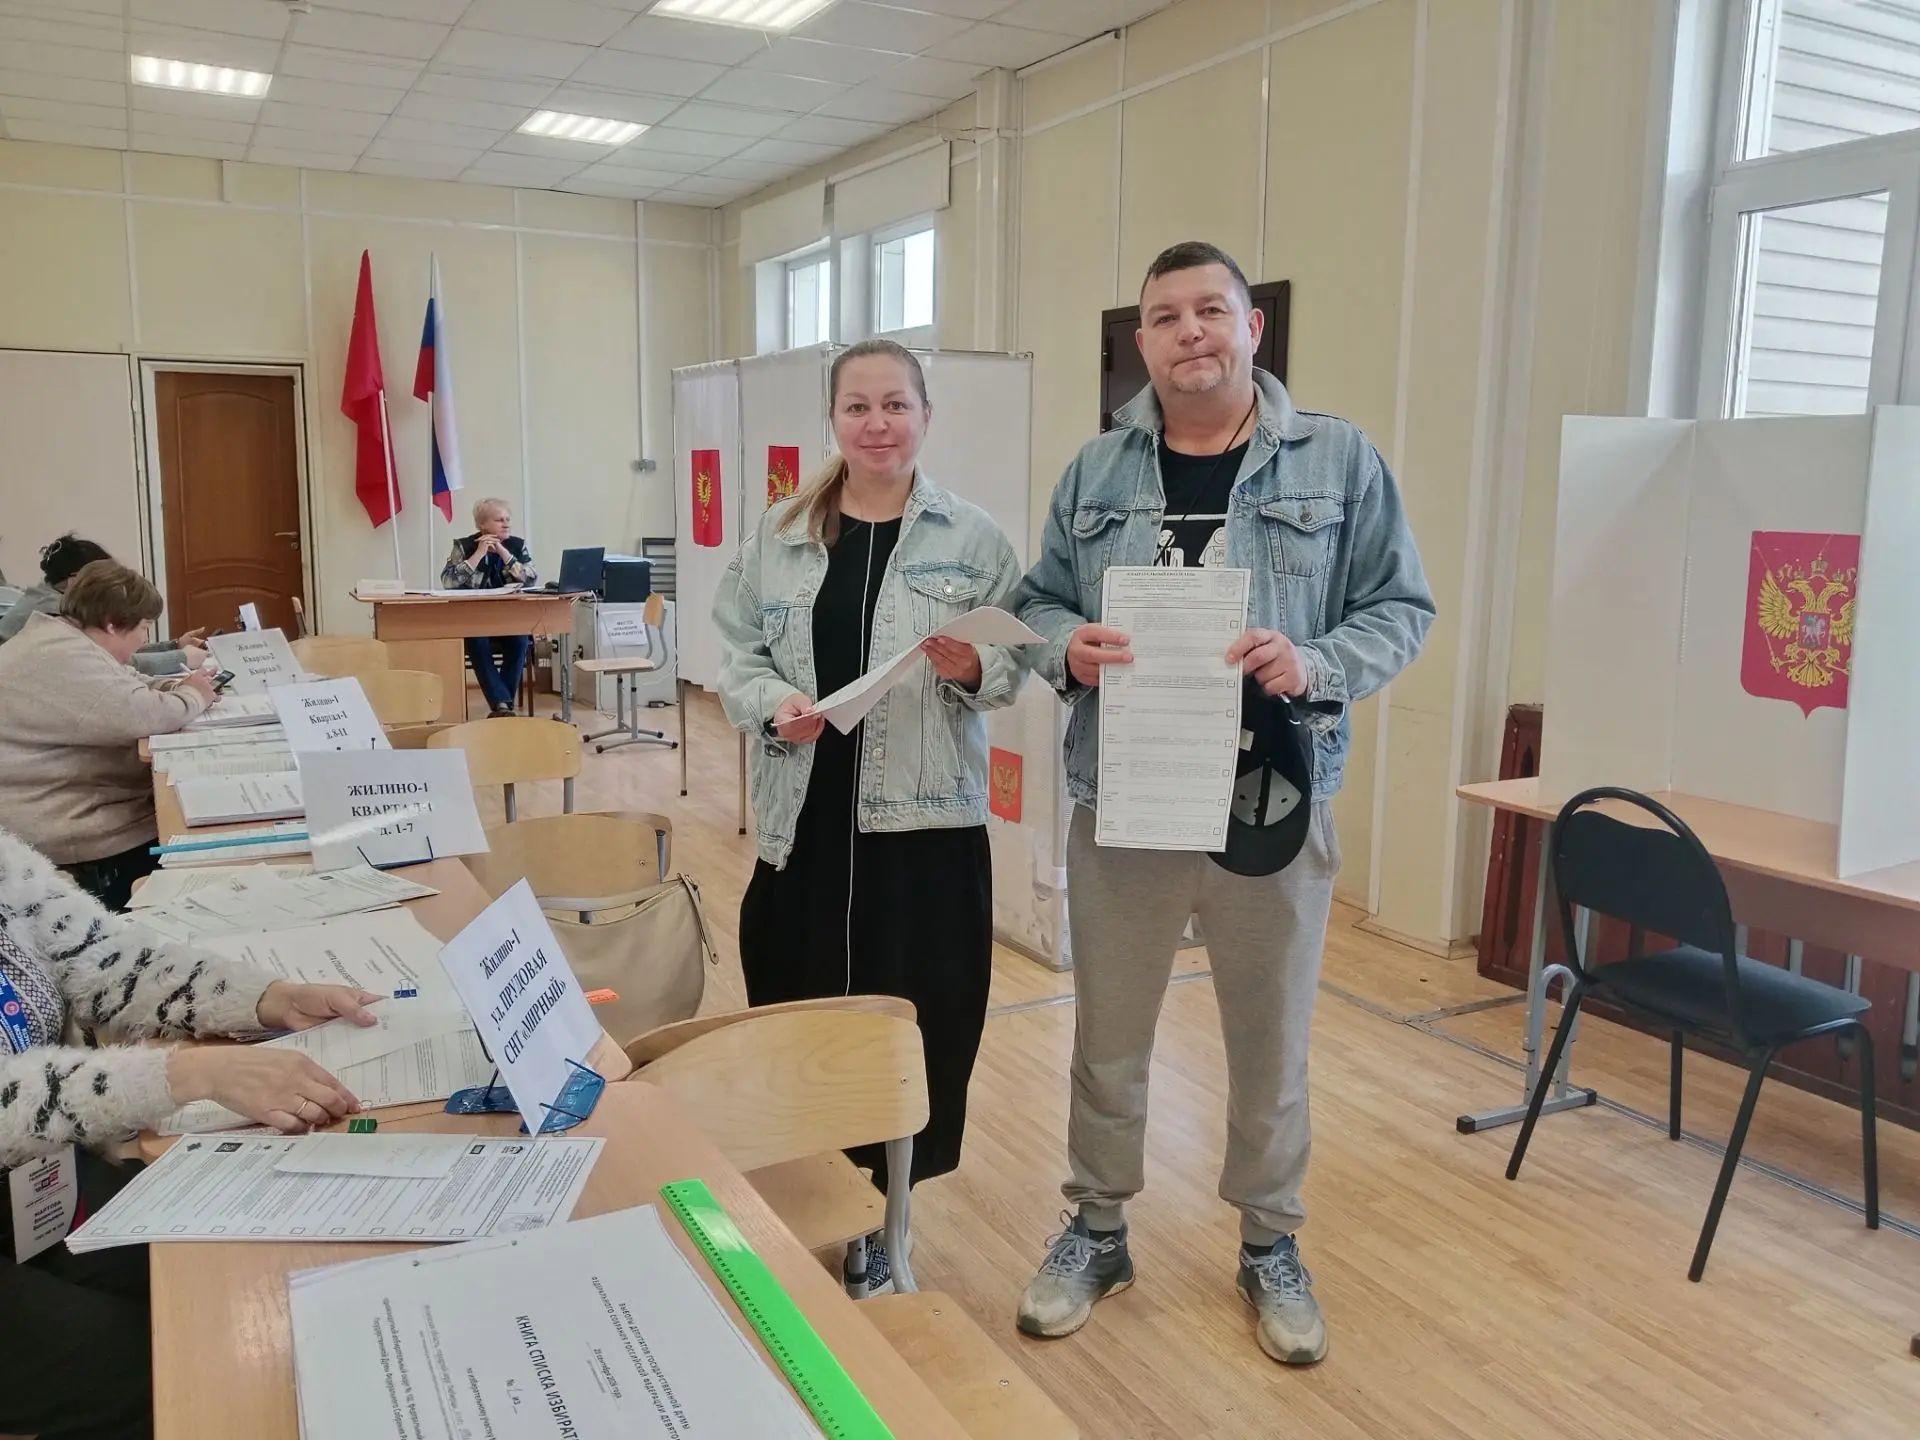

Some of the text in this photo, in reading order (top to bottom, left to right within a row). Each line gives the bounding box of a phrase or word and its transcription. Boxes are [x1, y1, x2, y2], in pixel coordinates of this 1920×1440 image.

[301, 695, 339, 708] Жилино-1
[309, 710, 348, 725] Квартал-1
[347, 782, 428, 797] ЖИЛИНО-1
[396, 822, 414, 834] 1-7
[479, 928, 521, 980] Жилино-1
[499, 948, 548, 1012] ПРУДОВАЯ
[503, 976, 567, 1064] СНТ «МИРНЫЙ»
[515, 1314, 580, 1440] КНИГА СПИСКА ИЗБИРАТ
[624, 1341, 650, 1378] РОССИЙСКОЙ
[643, 1376, 666, 1414] ФЕДЕРАЦИИ
[660, 1414, 681, 1440] ДЕВЯТО
[629, 1325, 651, 1356] ДЕПУТАТОВ
[646, 1354, 683, 1410] ГОСУДАРСТВЕННОЙ
[673, 1408, 691, 1430] ДУМЫ
